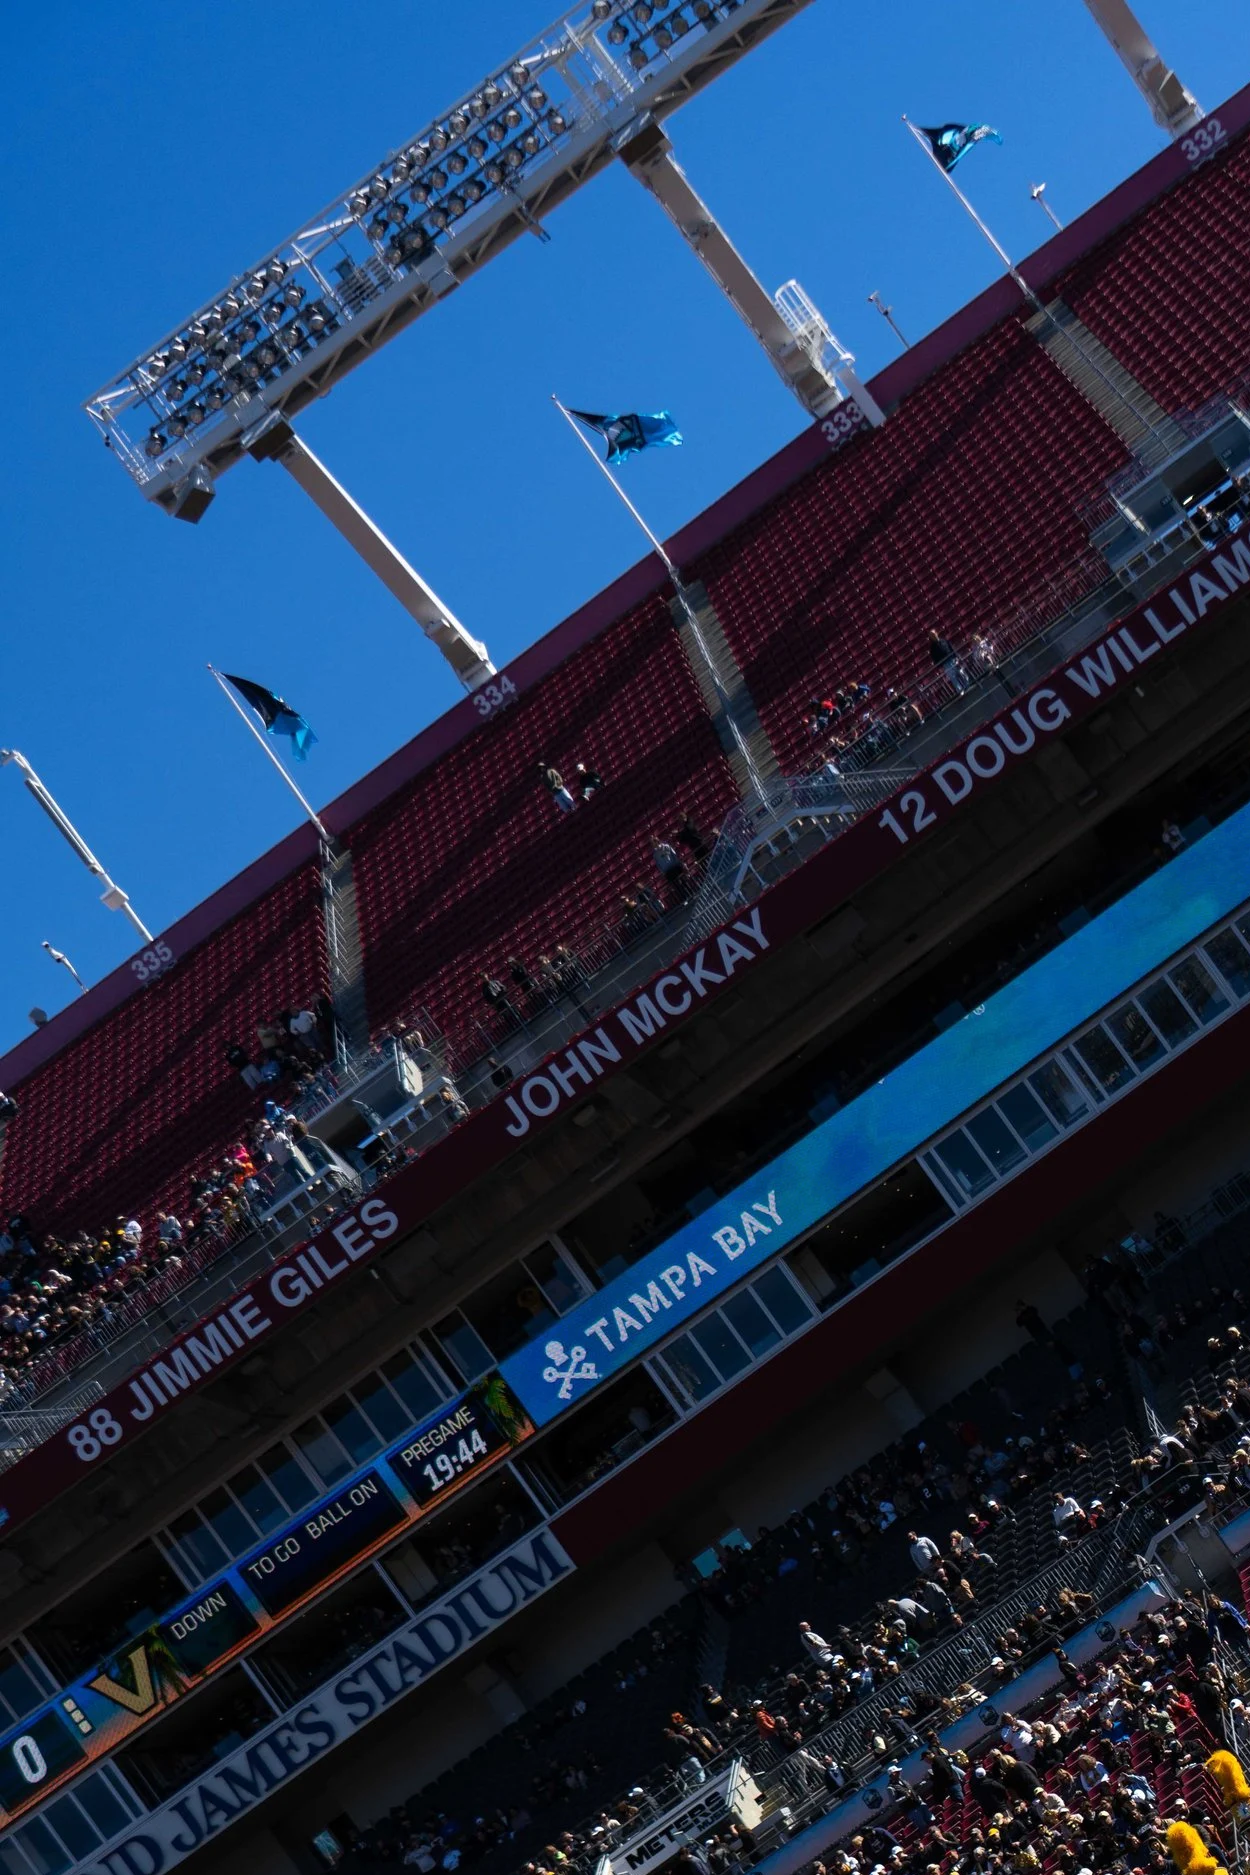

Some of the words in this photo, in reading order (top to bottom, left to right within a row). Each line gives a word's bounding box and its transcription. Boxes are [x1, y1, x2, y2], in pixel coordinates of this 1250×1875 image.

[1181, 119, 1228, 161] 332
[821, 402, 864, 442] 333
[474, 675, 516, 715] 334
[879, 792, 936, 843] 12
[933, 690, 1072, 804] DOUG
[131, 941, 173, 981] 335
[505, 1028, 621, 1138] JOHN
[618, 907, 770, 1045] MCKAY
[585, 1253, 717, 1351] TAMPA
[713, 1190, 784, 1260] BAY
[68, 1408, 122, 1462] 88
[129, 1294, 272, 1421] JIMMIE
[271, 1199, 398, 1307] GILES
[400, 1405, 476, 1467] PREGAME
[423, 1428, 488, 1492] 19:44
[305, 1500, 352, 1540] BALL
[349, 1479, 379, 1507] ON
[248, 1556, 276, 1580] TO
[274, 1537, 301, 1564] GO
[170, 1592, 228, 1640] DOWN
[170, 1703, 337, 1853] JAMES
[334, 1532, 571, 1726] STADIUM
[11, 1735, 48, 1785] 0
[625, 1791, 727, 1870] METERS
